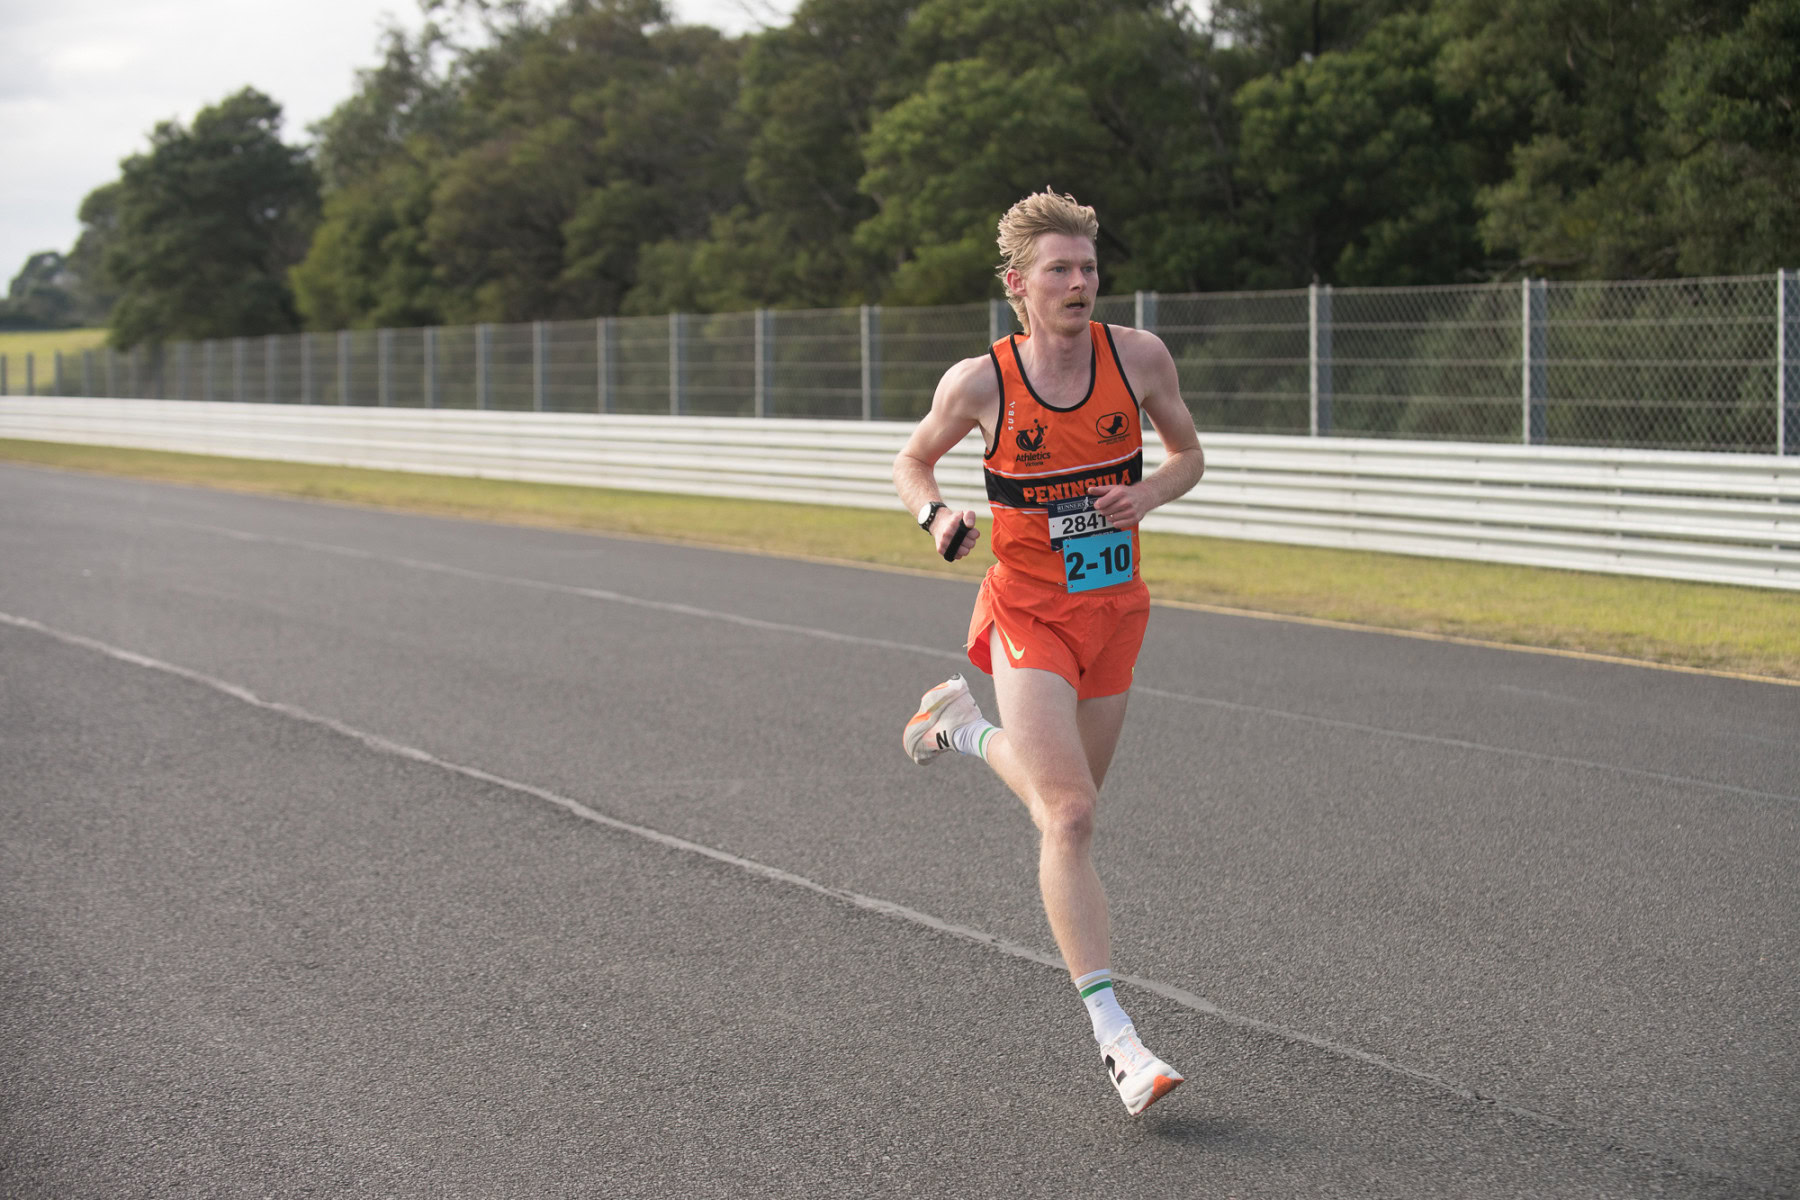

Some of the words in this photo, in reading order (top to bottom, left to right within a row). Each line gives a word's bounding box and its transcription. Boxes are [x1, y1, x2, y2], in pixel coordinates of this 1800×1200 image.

[1008, 401, 1016, 431] SUBA
[1016, 451, 1051, 462] Athletics
[1066, 543, 1131, 581] 2-10
